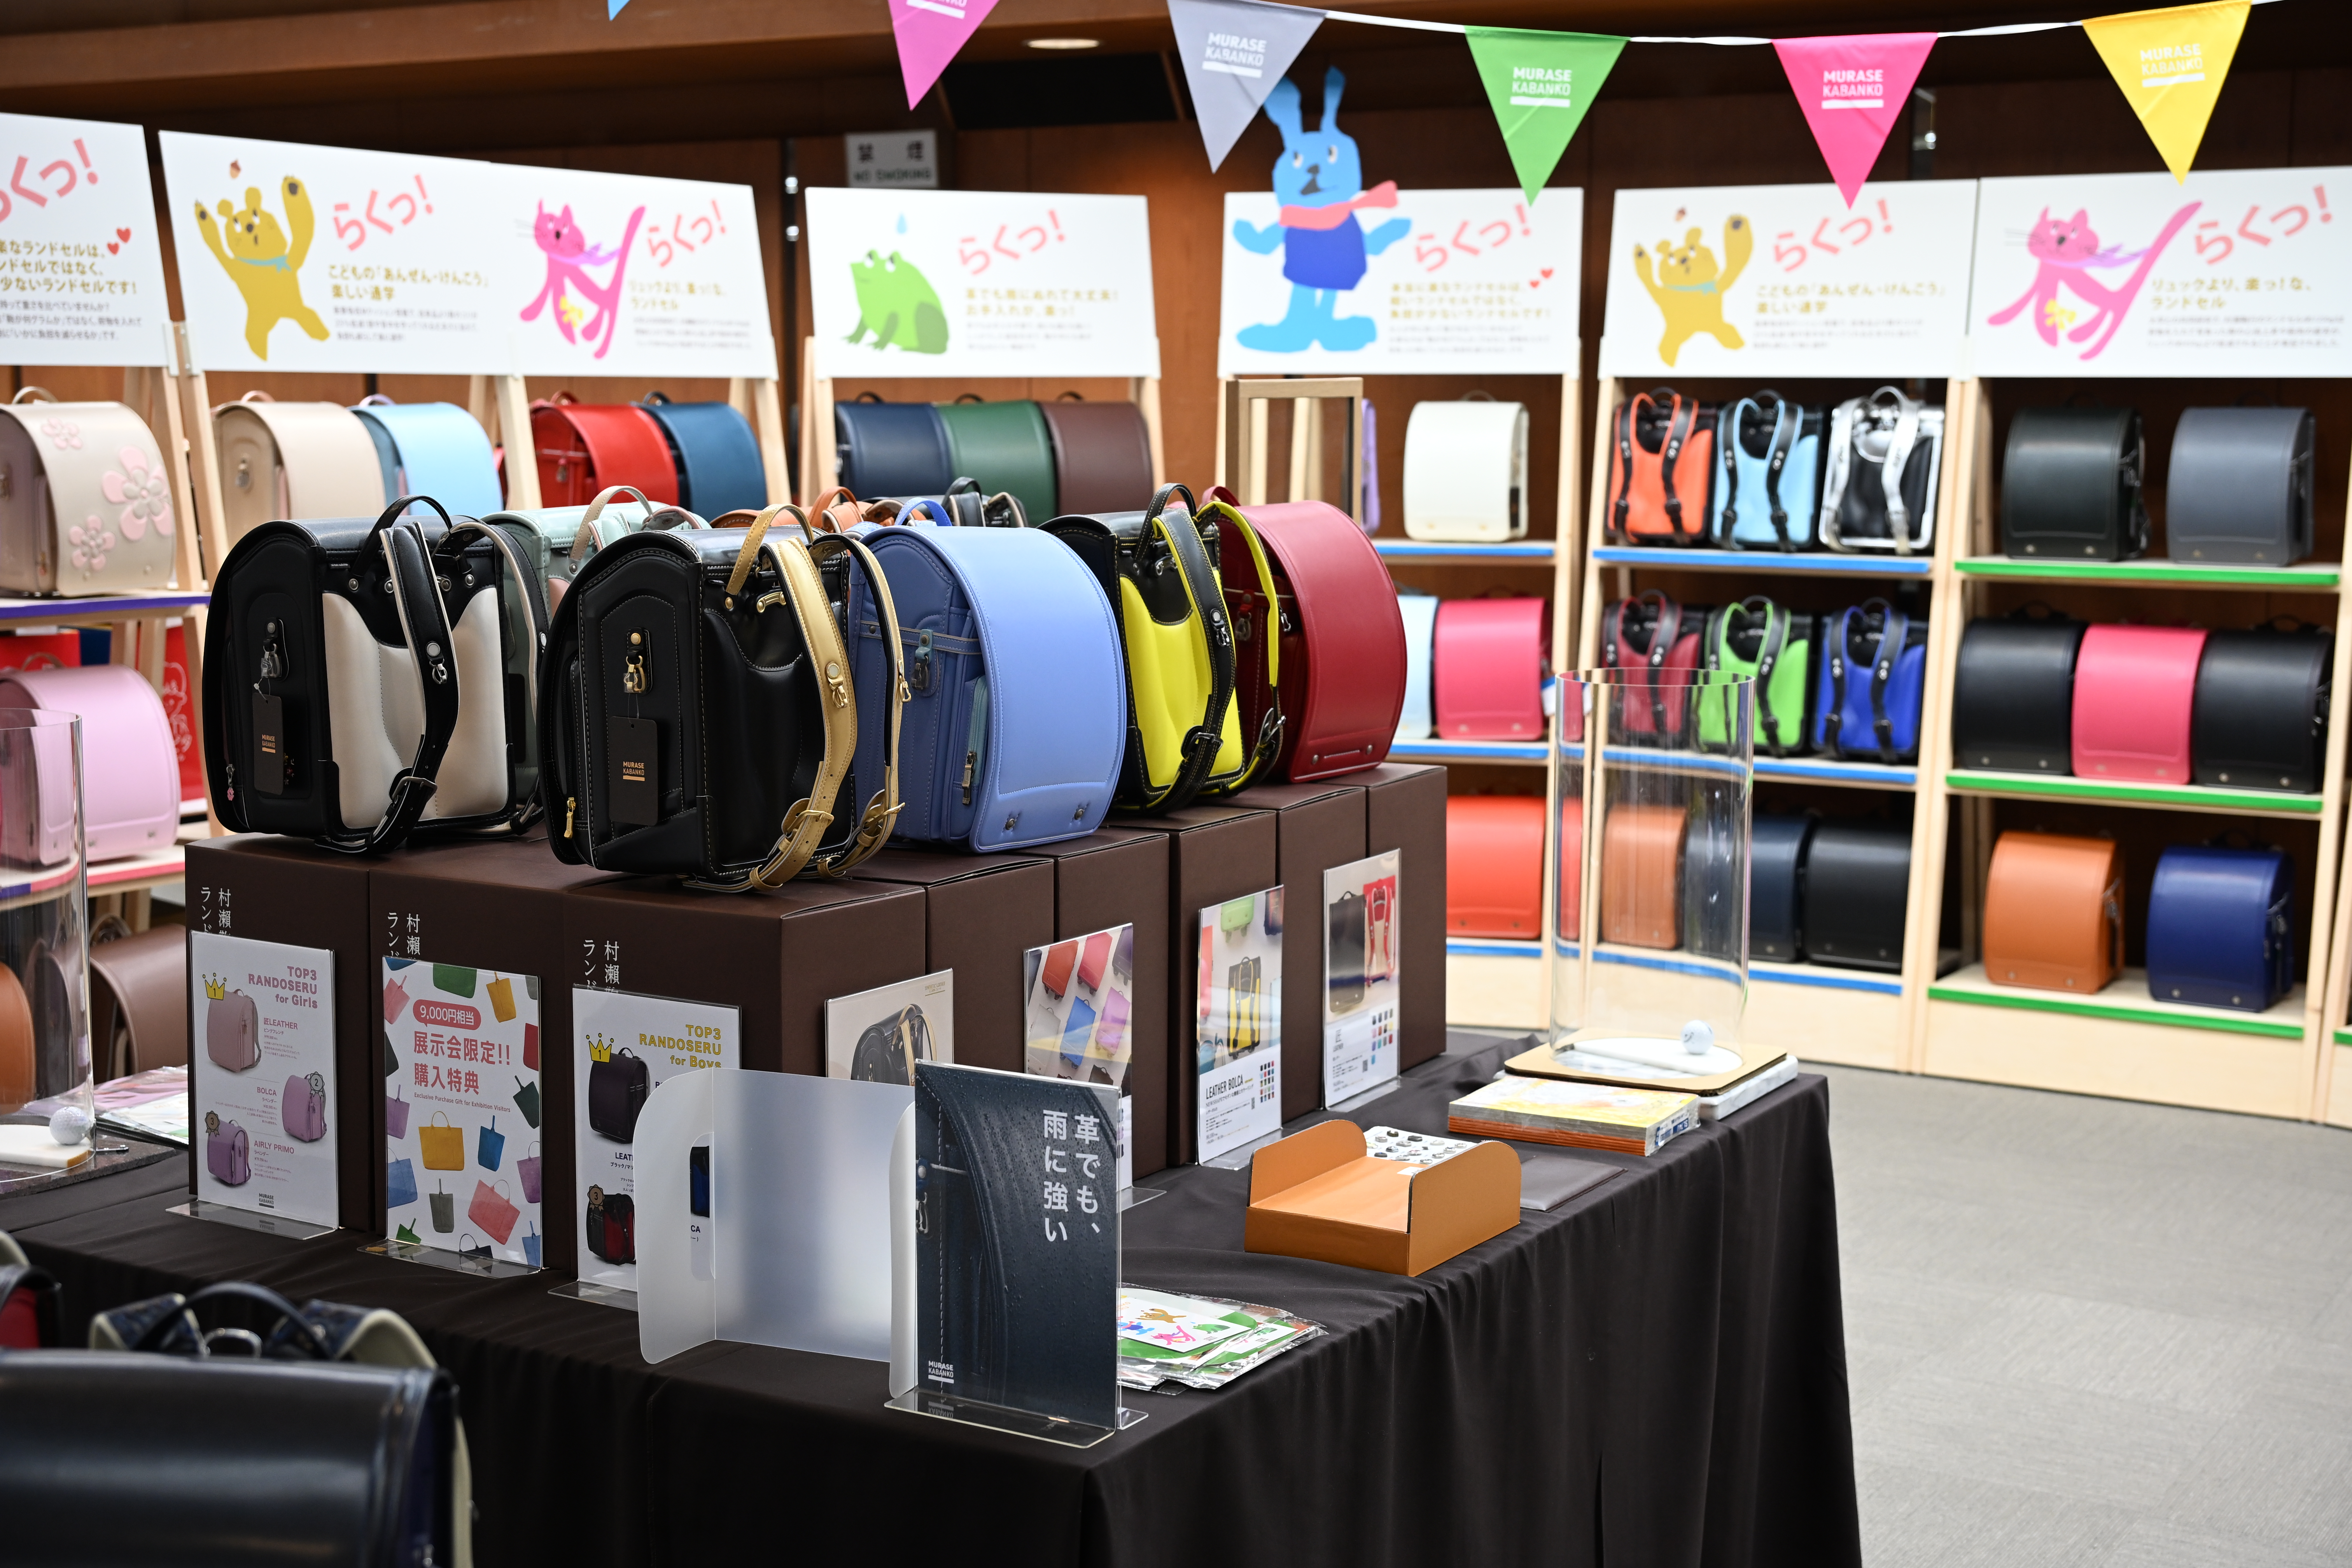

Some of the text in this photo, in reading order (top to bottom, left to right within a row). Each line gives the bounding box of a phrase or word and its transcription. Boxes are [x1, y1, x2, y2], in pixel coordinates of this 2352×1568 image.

[1208, 32, 1267, 53] MURASE
[1205, 46, 1264, 67] KABANKO
[2140, 43, 2202, 62] MURASE
[1513, 66, 1572, 82] MURASE
[2142, 57, 2203, 75] KABANKO
[1823, 69, 1884, 83] MURASE
[1512, 81, 1571, 96] KABANKO
[1823, 83, 1883, 97] KABANKO
[0, 138, 98, 222] くっ!
[287, 966, 317, 980] TOP3
[248, 974, 317, 994] RANDOSERU
[275, 994, 318, 1009] for Girls
[420, 1005, 474, 1026] 9,000円相当
[686, 1024, 721, 1040] TOP3
[414, 1031, 510, 1066] 展示会限定!!
[639, 1033, 721, 1055] RANDOSERU
[670, 1055, 686, 1066] for
[414, 1062, 480, 1095] 購入特典
[1206, 1074, 1243, 1099] LEATHER BOLCA
[257, 1087, 277, 1096] BOLCA
[414, 1093, 434, 1101] Exclusive
[435, 1095, 454, 1104] Purchase
[471, 1101, 493, 1110] Exhibition
[494, 1104, 511, 1113] Visitors
[254, 1140, 294, 1154] AIRLY PRIMO
[1043, 1109, 1069, 1242] 雨に強い
[1074, 1113, 1100, 1234] 革でも、
[594, 1192, 598, 1200] 3
[928, 1360, 954, 1371] MURASE
[928, 1367, 954, 1378] KABANKO
